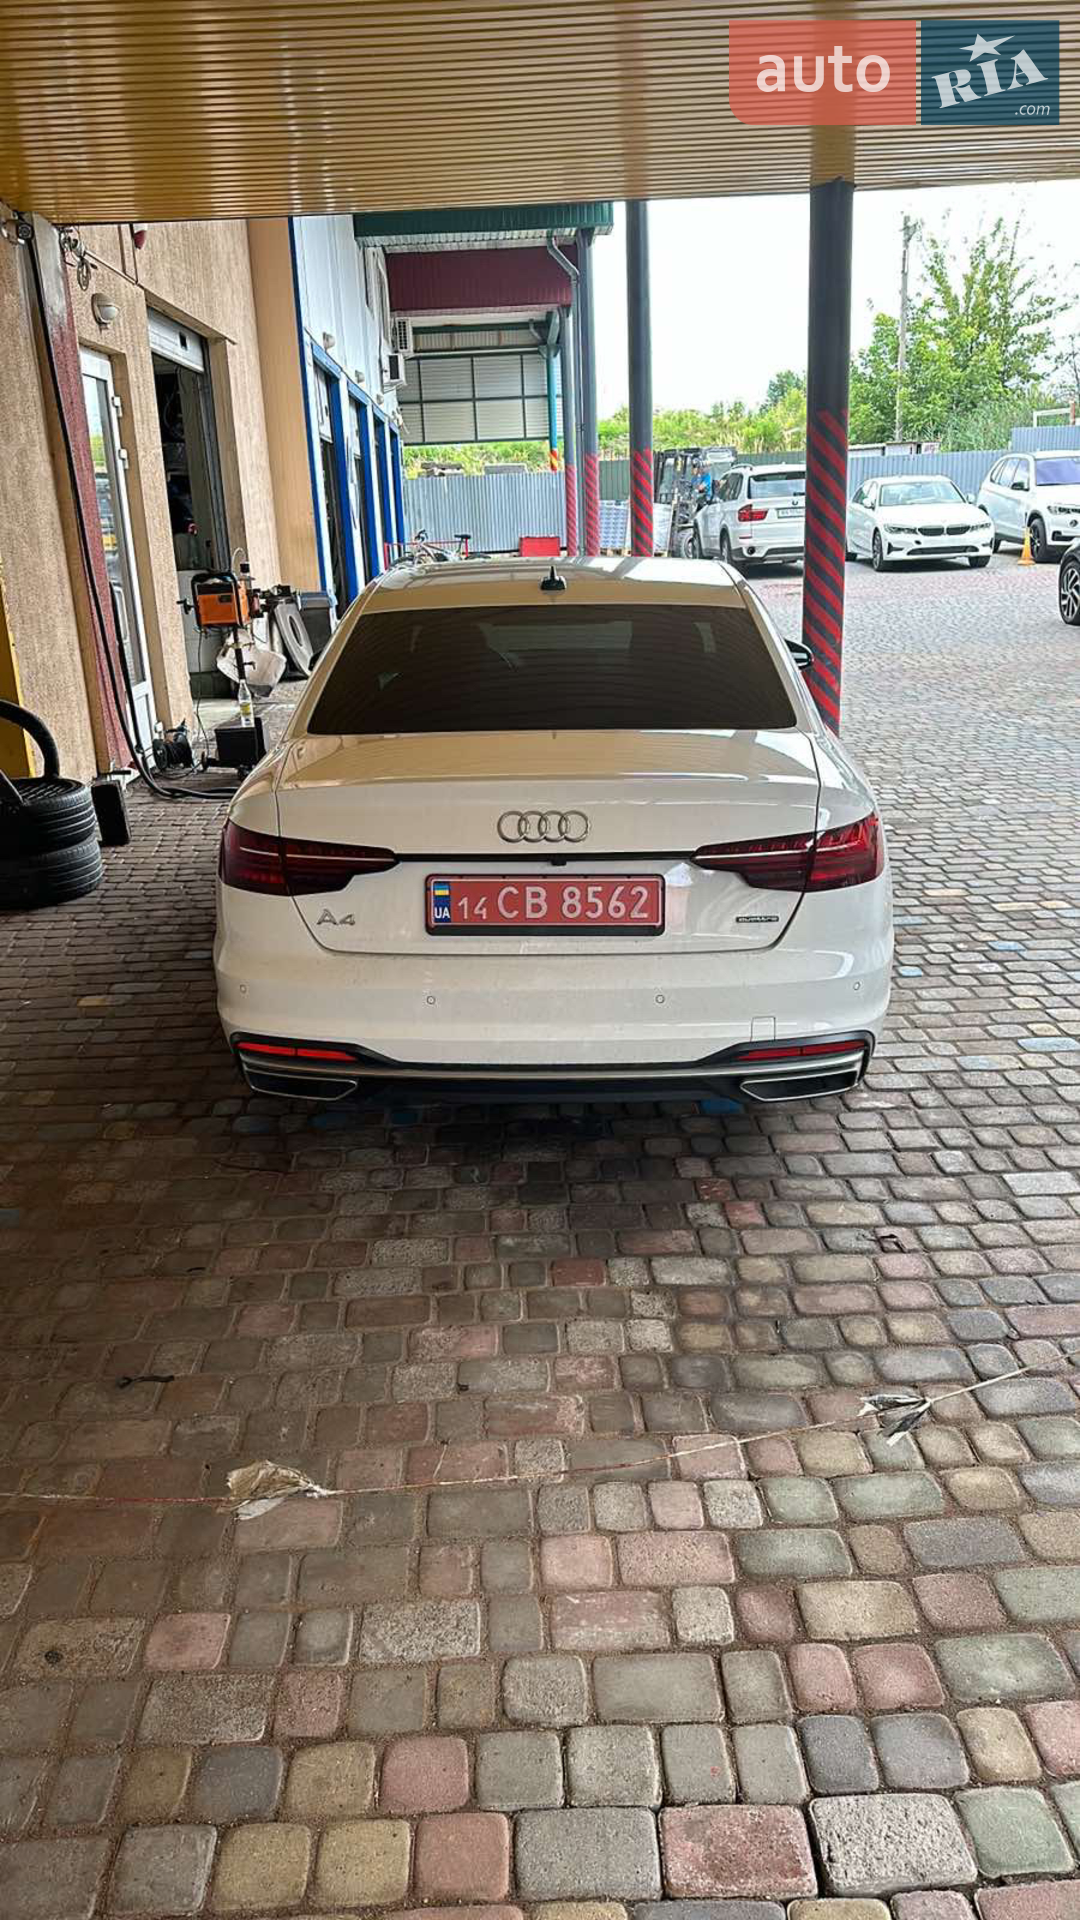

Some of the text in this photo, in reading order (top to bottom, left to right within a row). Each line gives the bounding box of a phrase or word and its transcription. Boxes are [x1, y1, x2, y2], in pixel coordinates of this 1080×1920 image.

[458, 886, 649, 919] 14 CB 8562
[317, 908, 356, 926] A4
[434, 906, 450, 919] UA
